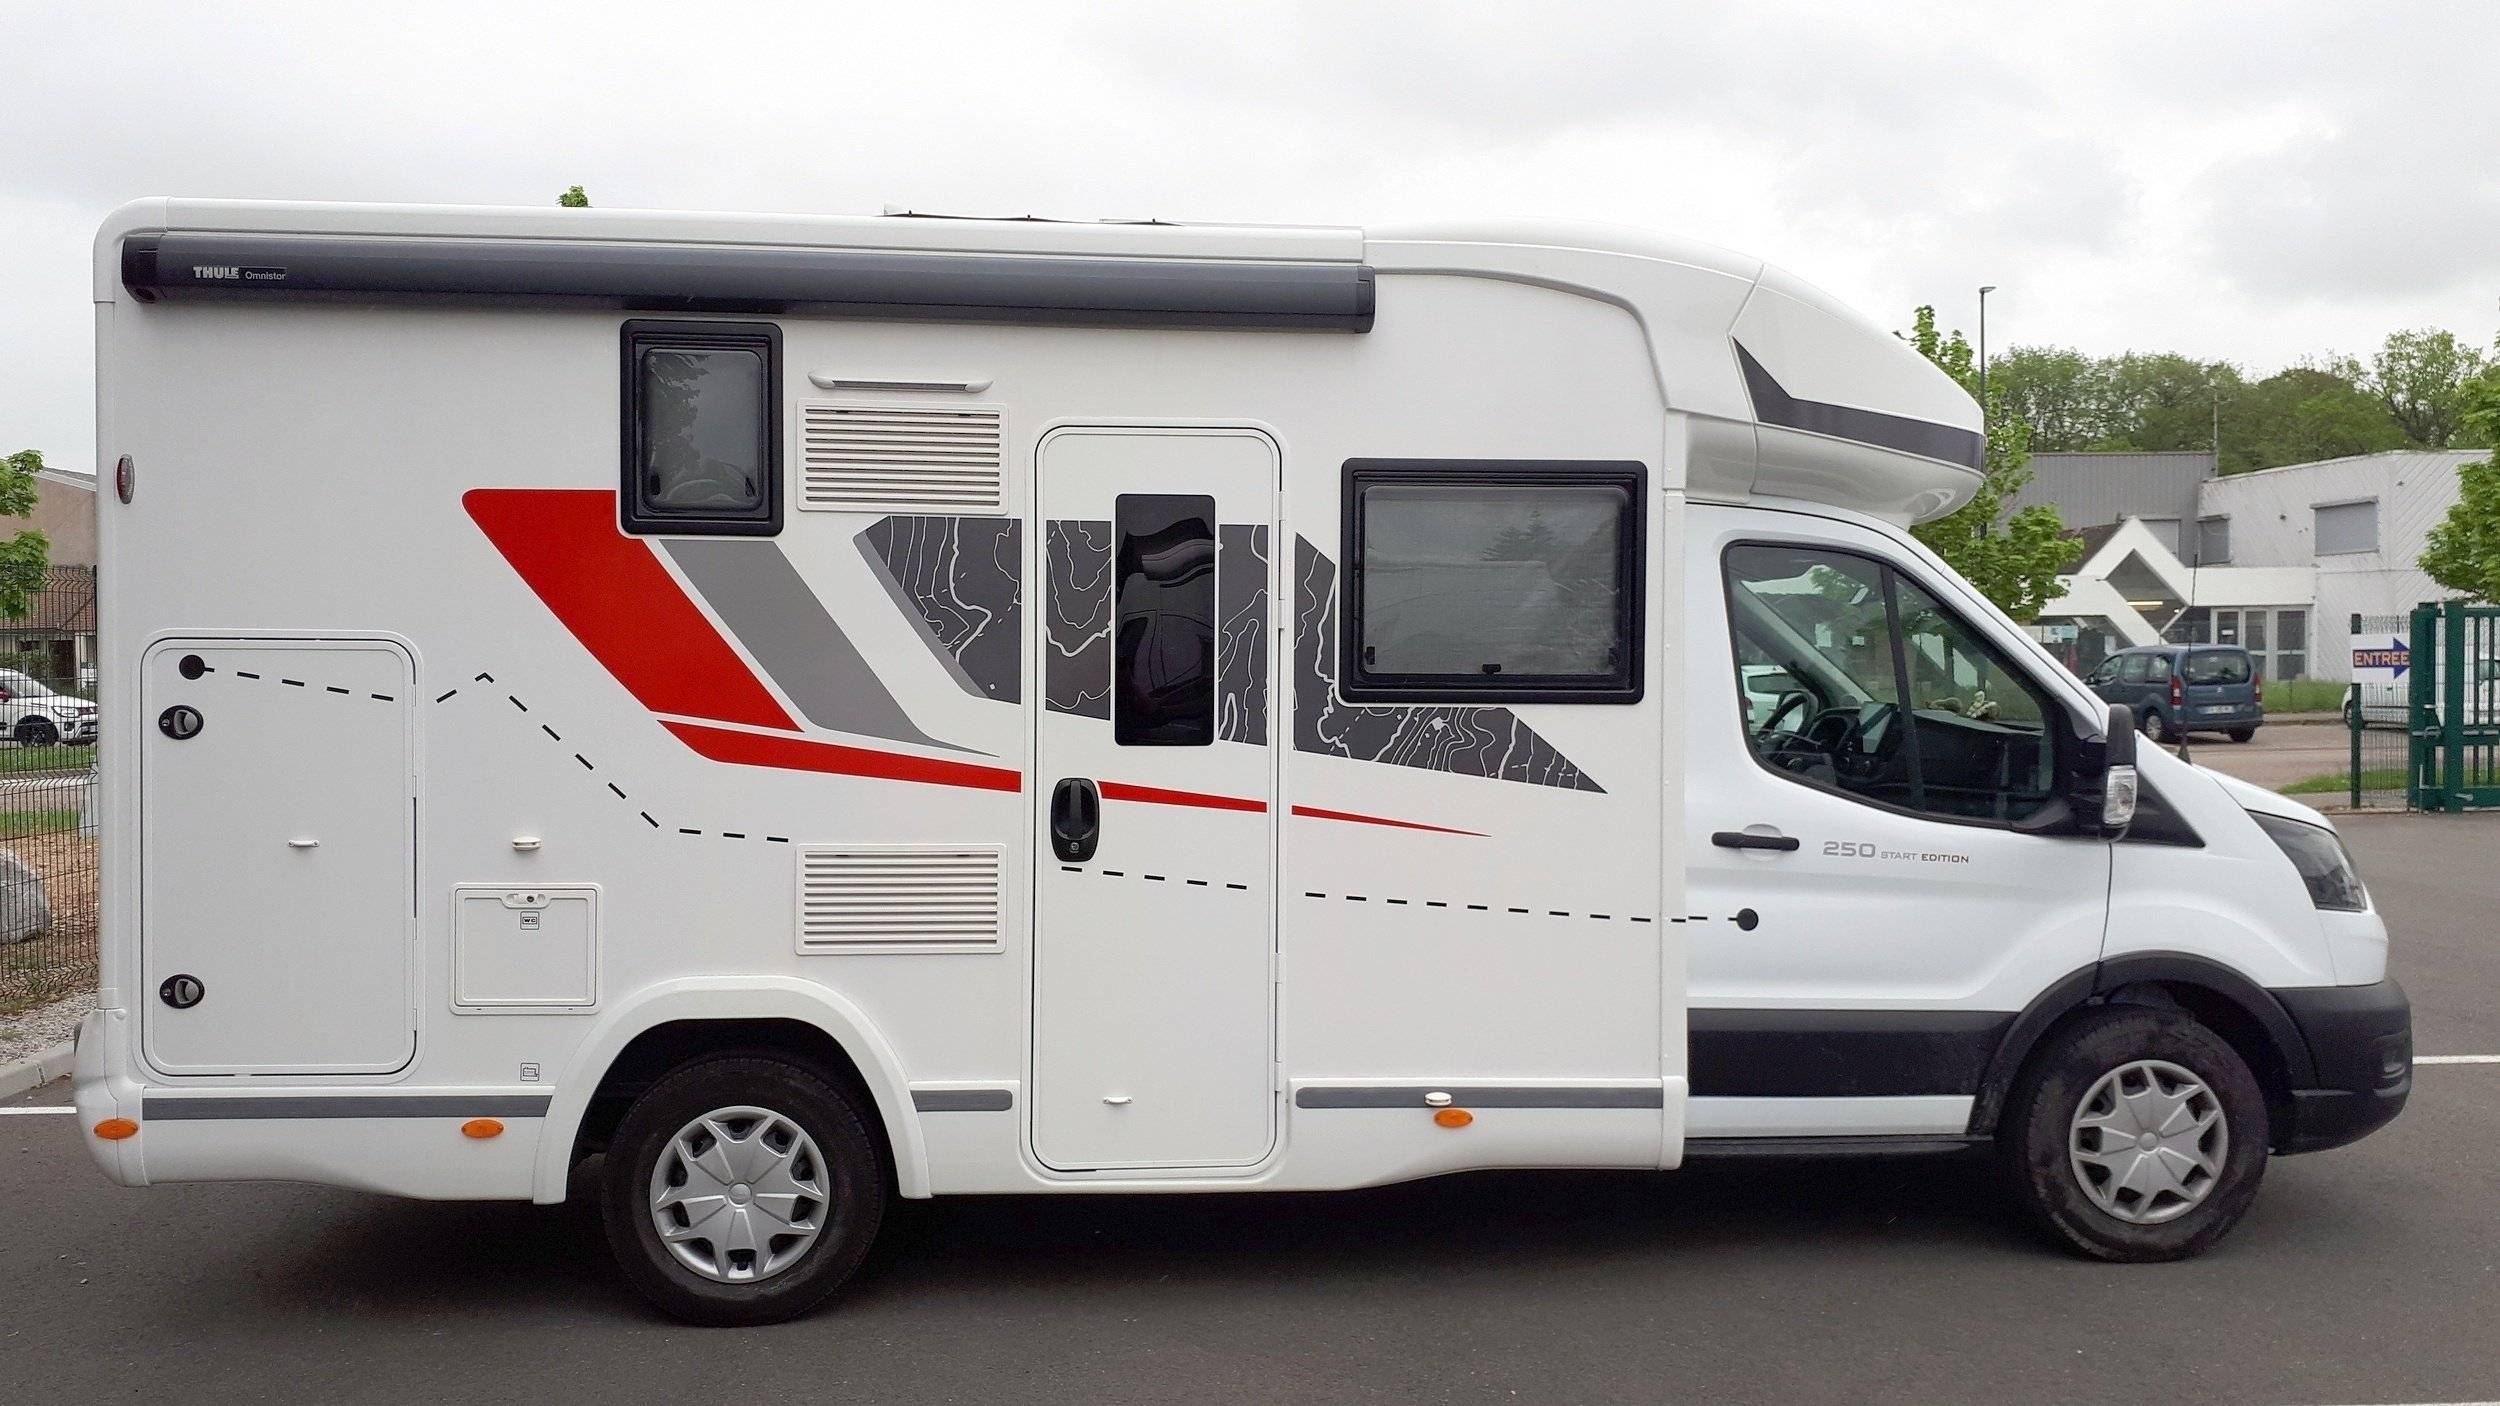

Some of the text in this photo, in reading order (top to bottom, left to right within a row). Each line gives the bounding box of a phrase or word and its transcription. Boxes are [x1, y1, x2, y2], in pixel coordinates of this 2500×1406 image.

[193, 266, 286, 280] THULE Omnistor
[2354, 651, 2410, 666] ENTREE
[1822, 841, 1970, 863] 250 START EDITION
